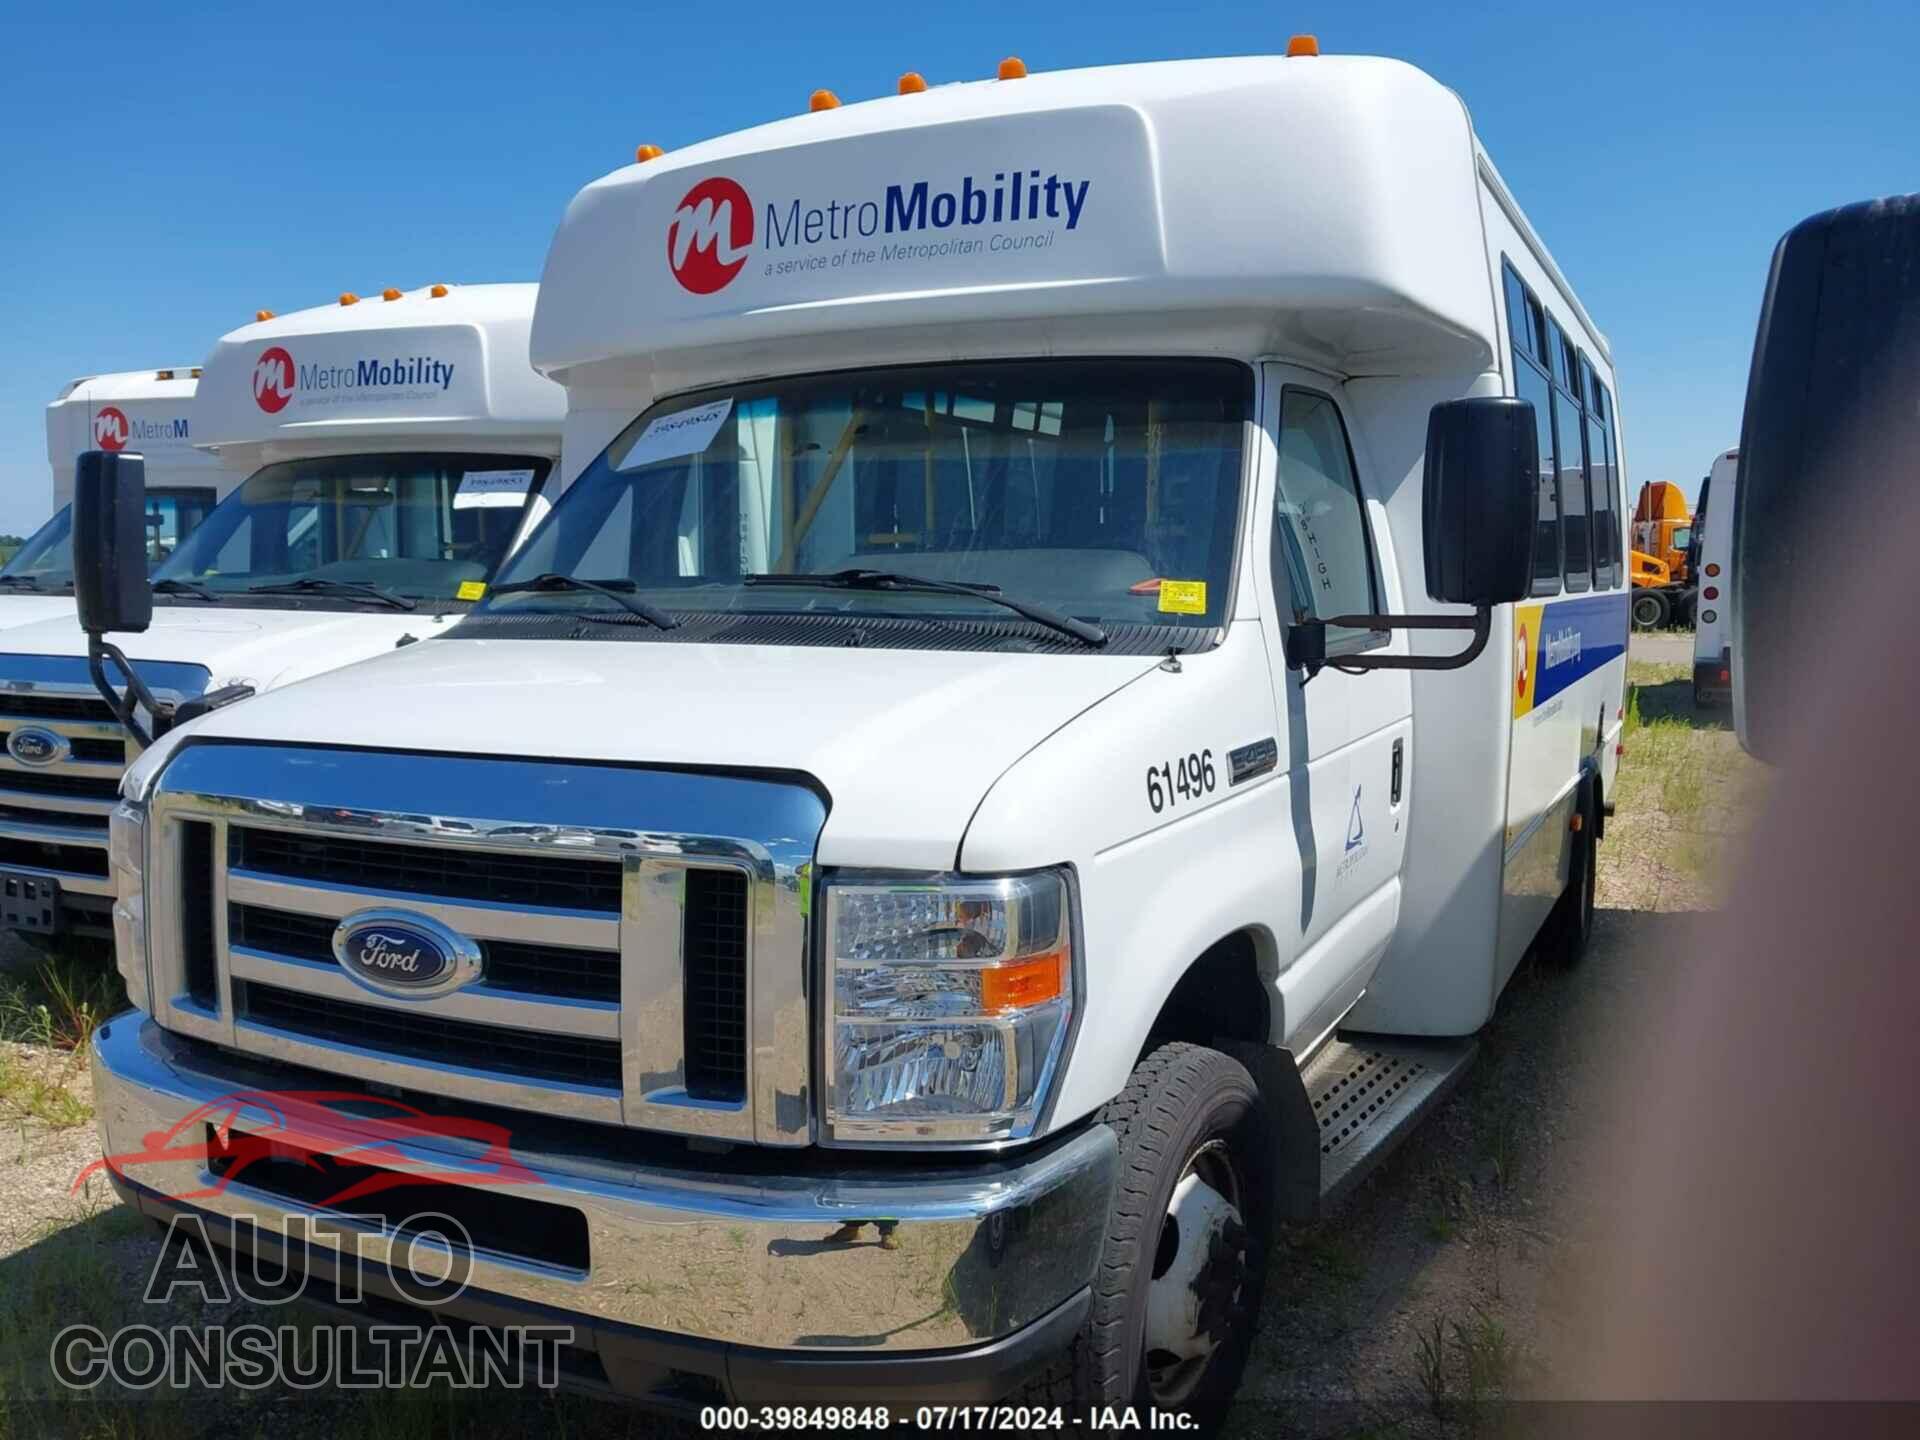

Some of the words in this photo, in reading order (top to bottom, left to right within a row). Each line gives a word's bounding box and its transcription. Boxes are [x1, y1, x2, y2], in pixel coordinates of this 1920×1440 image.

[765, 169, 1090, 249] MetroMobility
[764, 263, 773, 276] a
[776, 255, 827, 274] service
[831, 249, 847, 268] of
[850, 247, 876, 265] the
[880, 238, 983, 262] Metropolitan
[990, 230, 1055, 251] Council
[300, 357, 454, 390] MetroMobility
[1147, 749, 1216, 813] 61496
[360, 933, 421, 973] Ford
